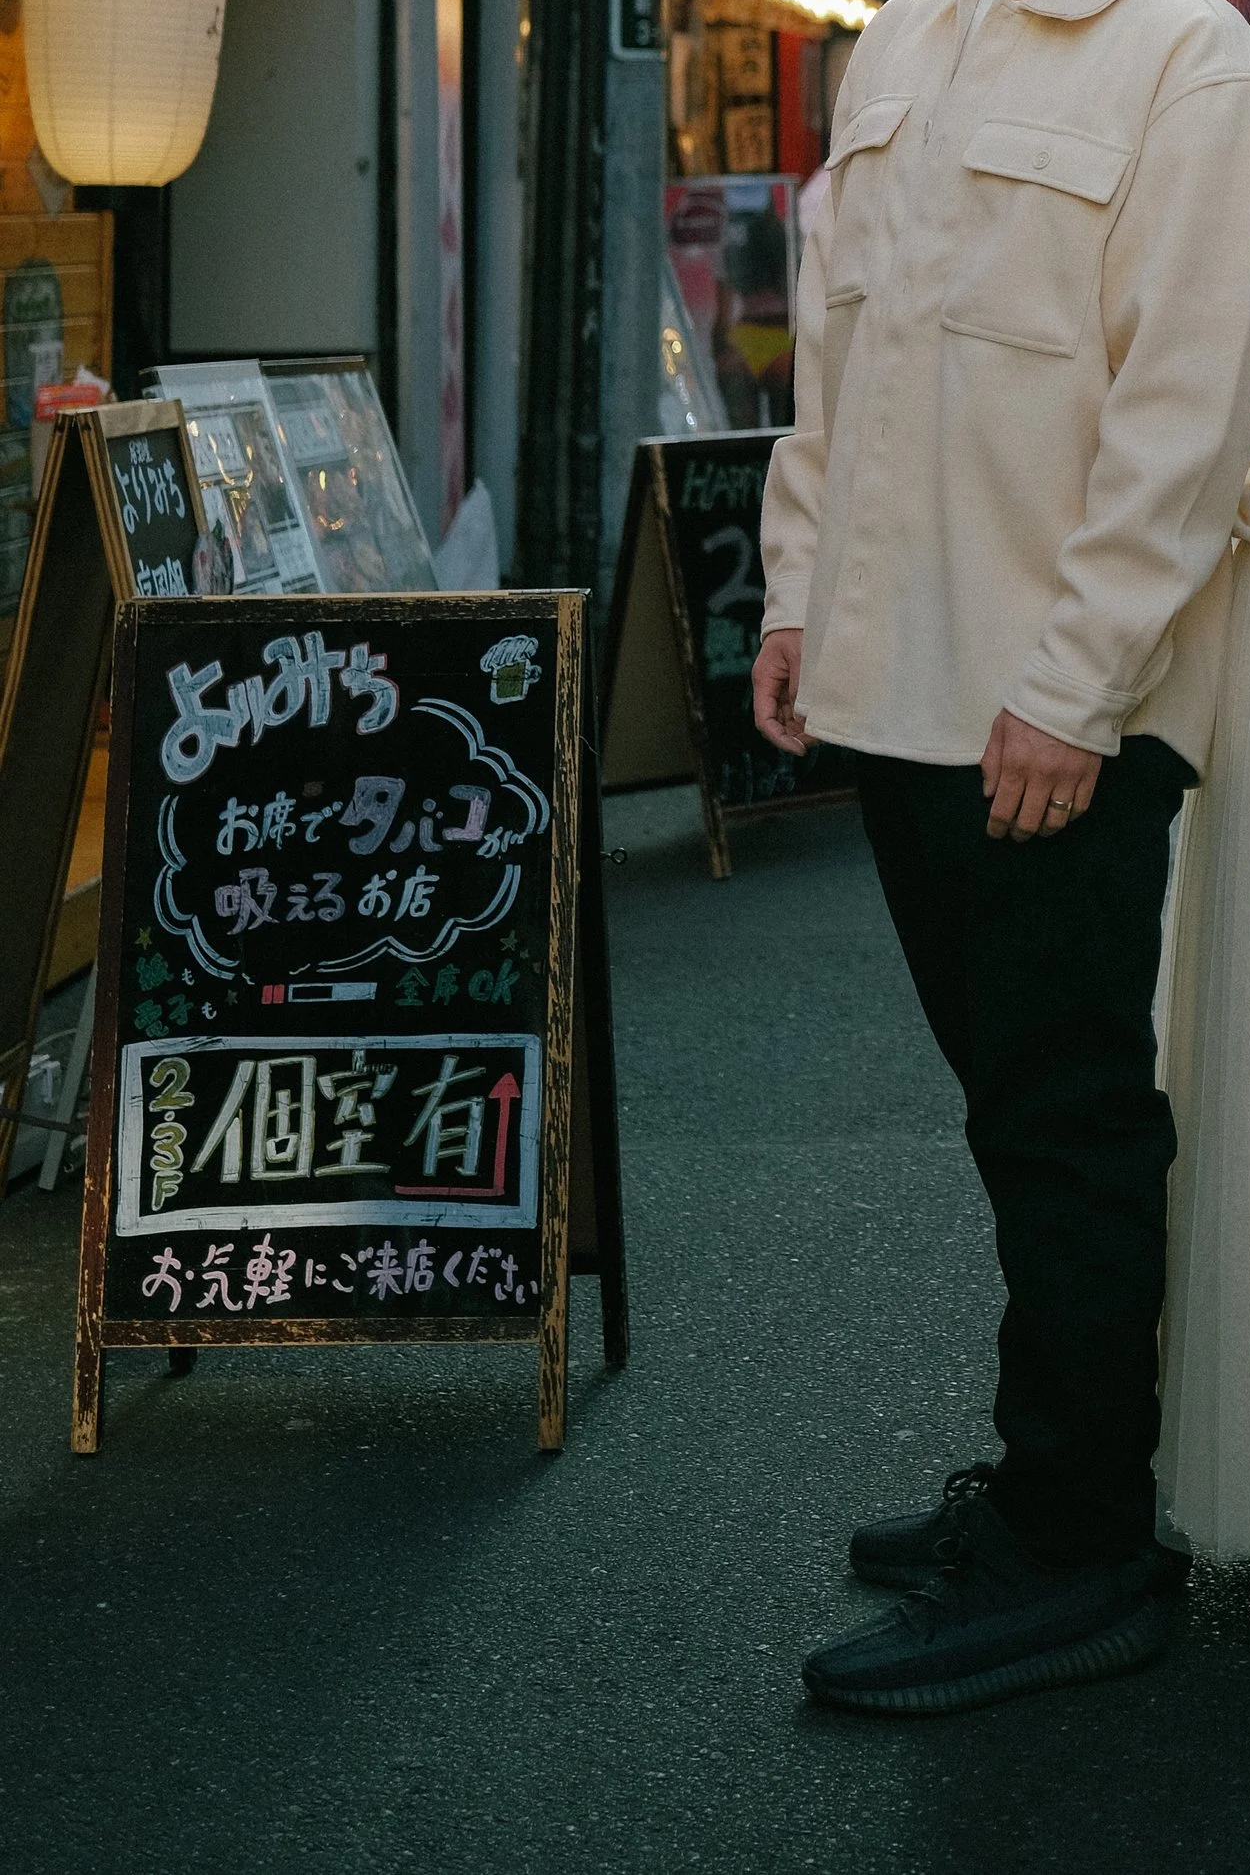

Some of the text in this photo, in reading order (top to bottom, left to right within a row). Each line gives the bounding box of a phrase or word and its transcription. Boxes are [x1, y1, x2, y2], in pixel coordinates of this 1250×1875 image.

[114, 458, 185, 535] よりみち
[160, 630, 400, 784] よりみち
[214, 864, 441, 935] 吸えるお店
[134, 994, 218, 1038] 電子も
[190, 1049, 487, 1184] 個室有
[142, 1232, 540, 1313] お気軽にご来店ください
